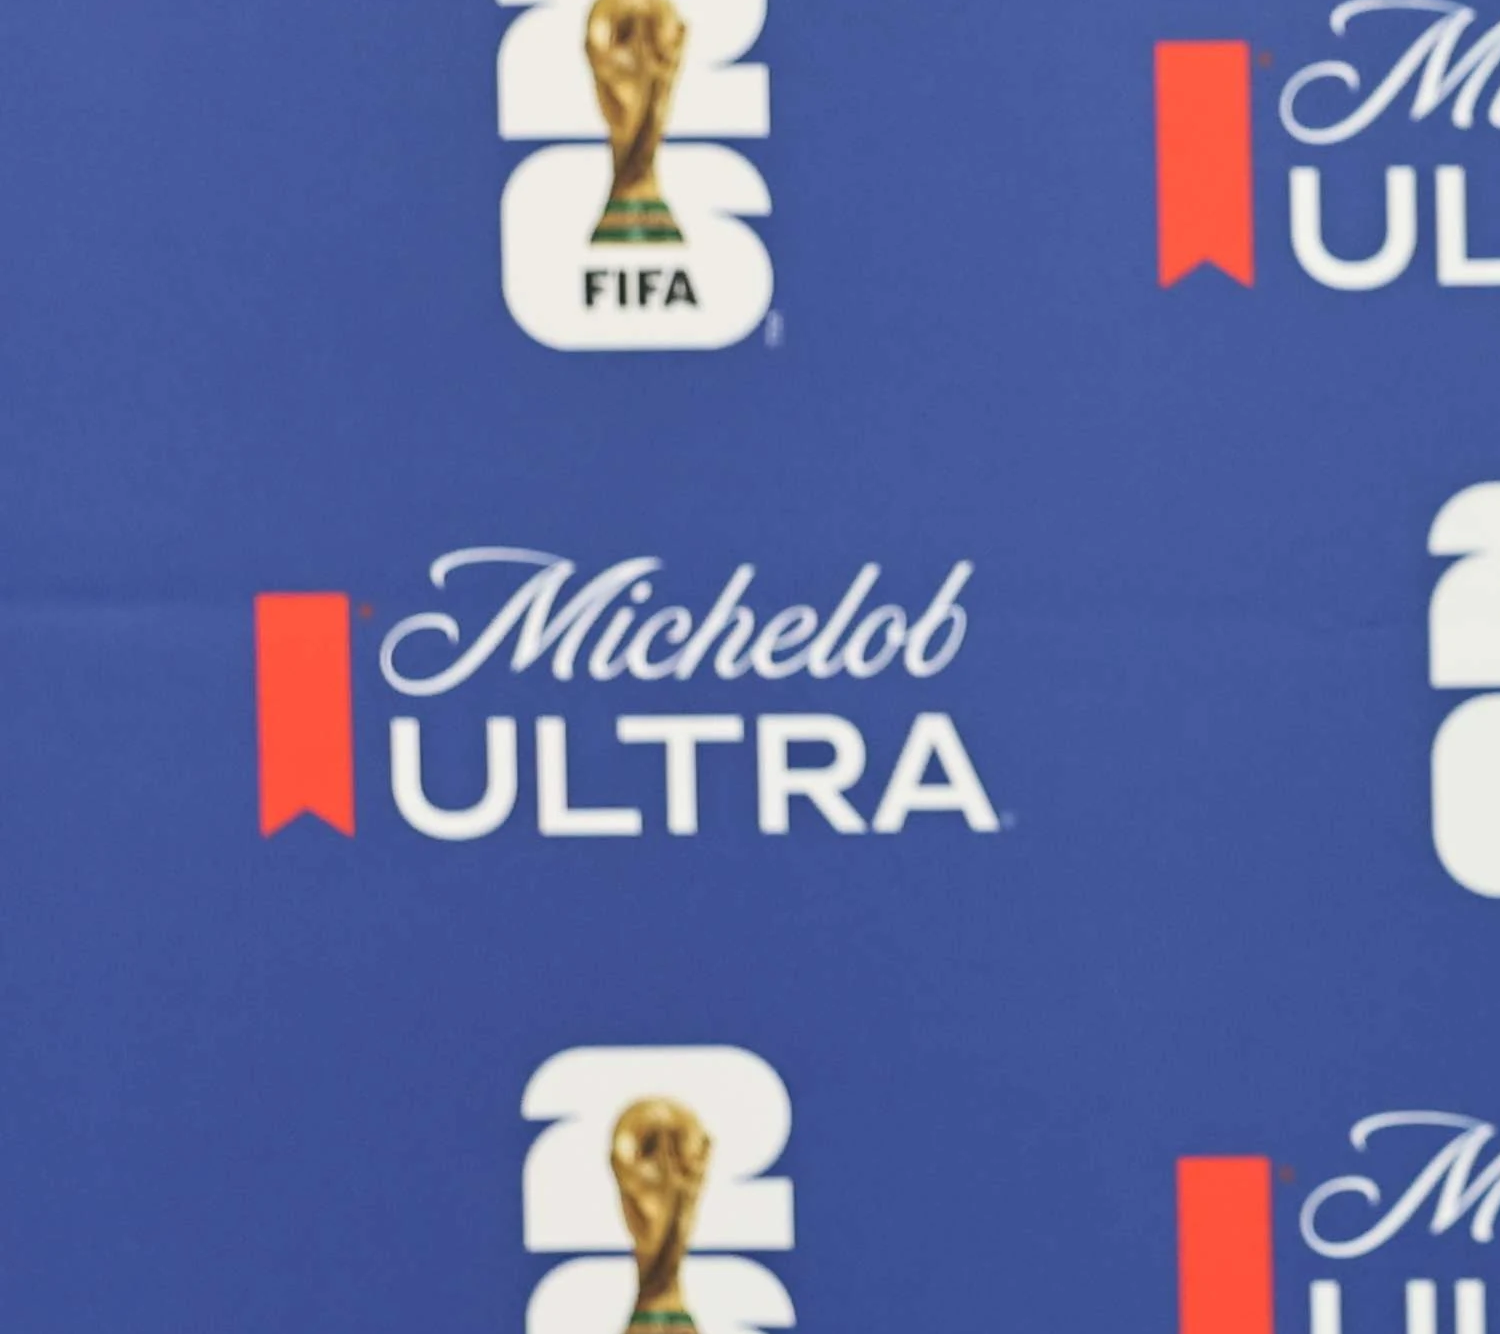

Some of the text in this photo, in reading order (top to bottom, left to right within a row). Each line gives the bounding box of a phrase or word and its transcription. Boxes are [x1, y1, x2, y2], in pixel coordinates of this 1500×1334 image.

[585, 270, 697, 307] FIFA
[380, 547, 972, 696] Michelob
[390, 712, 1000, 840] ULTRA
